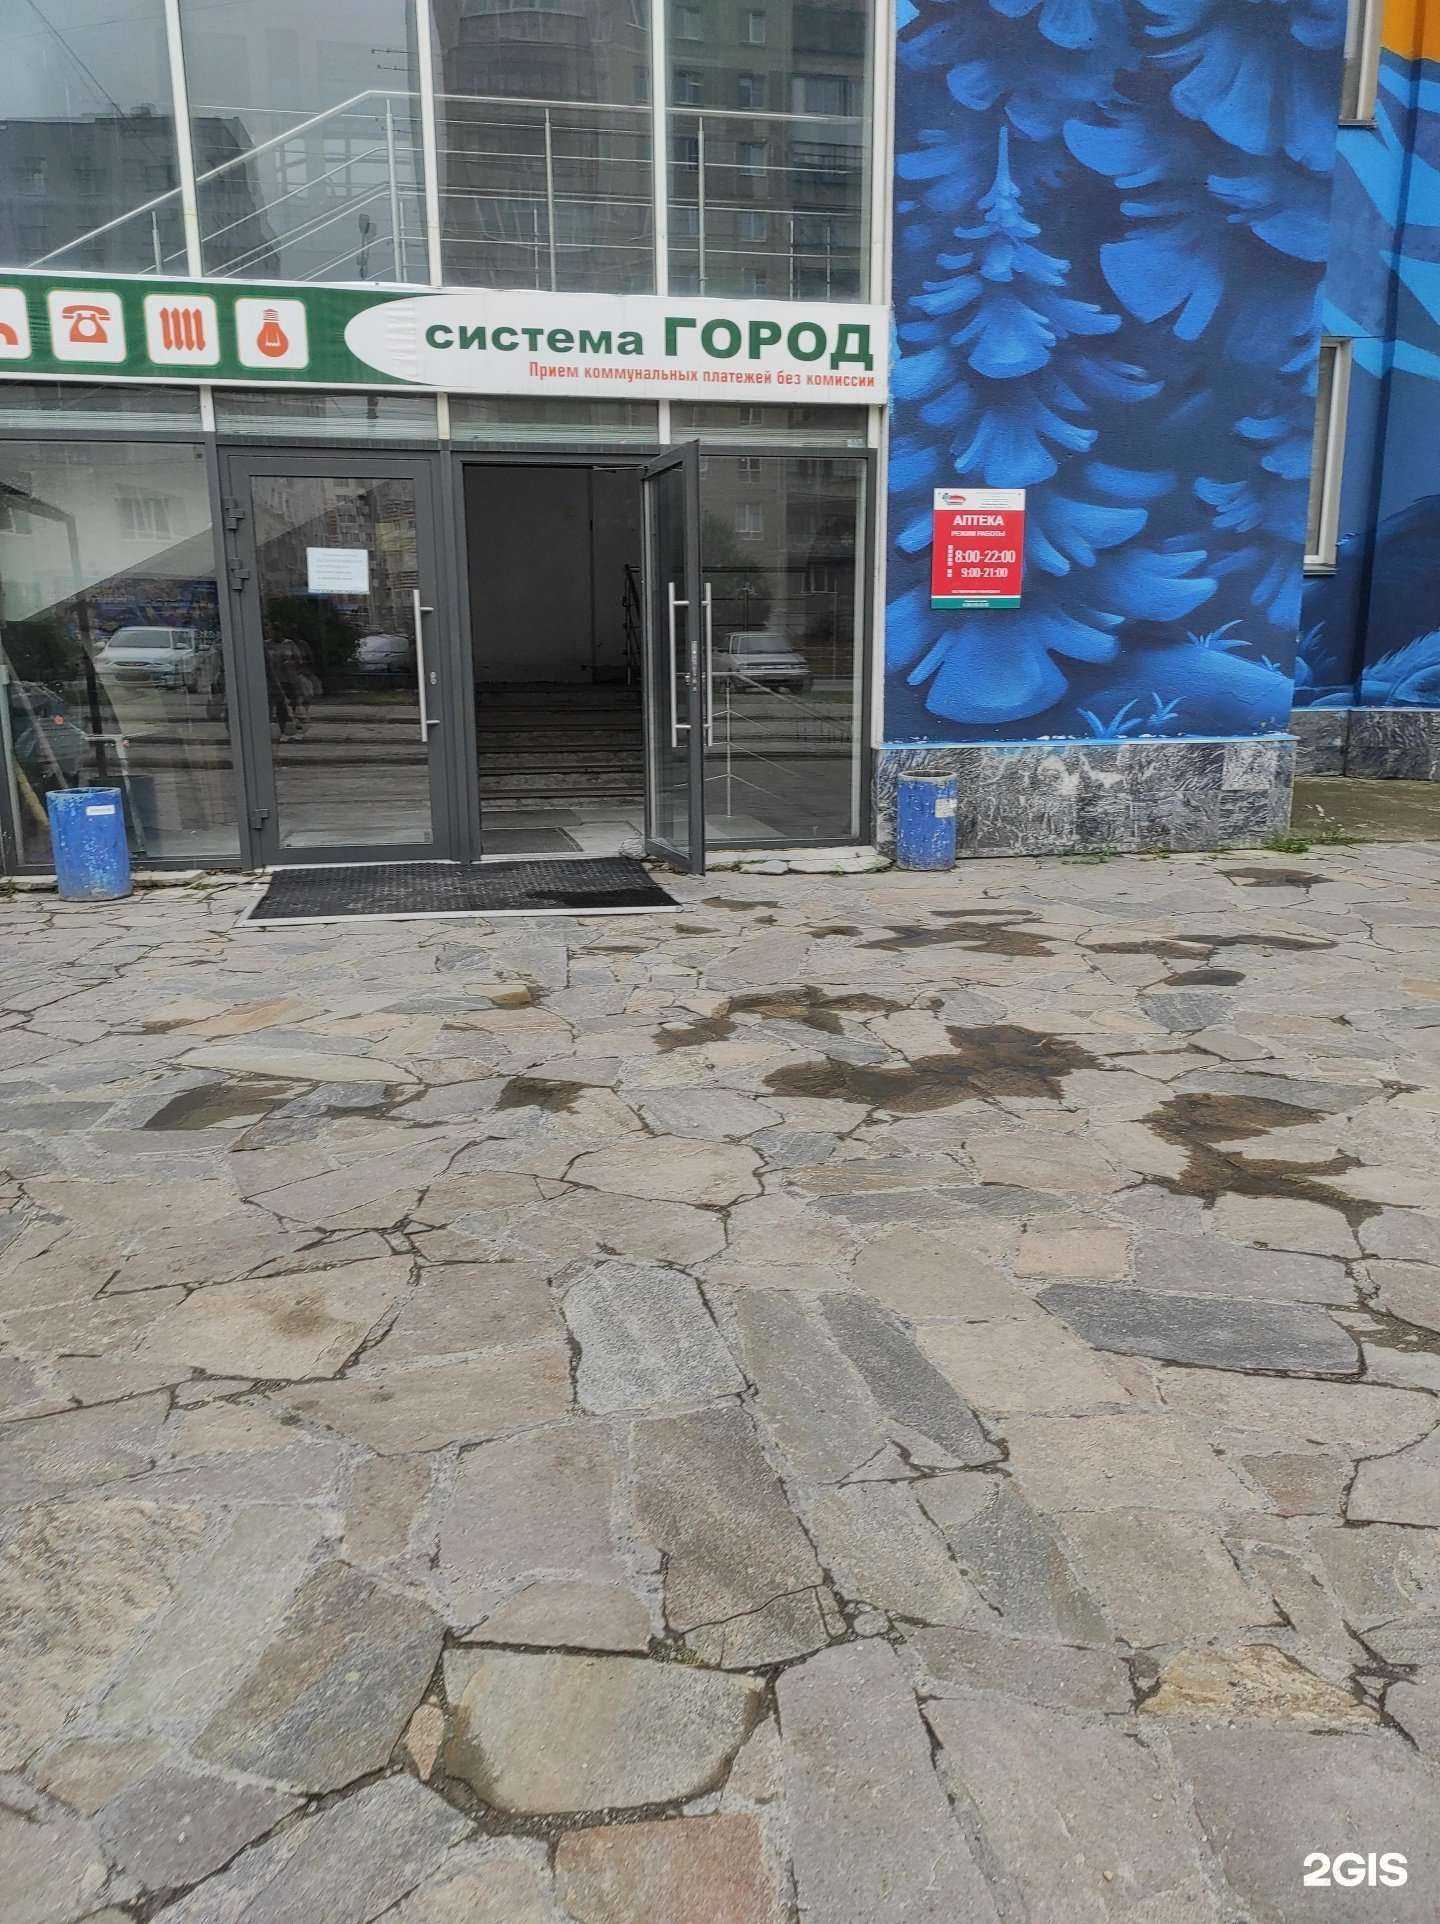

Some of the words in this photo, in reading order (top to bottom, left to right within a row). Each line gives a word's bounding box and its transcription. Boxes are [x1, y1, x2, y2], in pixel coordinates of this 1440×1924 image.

[425, 323, 644, 356] система
[664, 316, 875, 372] ГОРОД
[529, 361, 579, 380] Прием
[584, 365, 698, 383] коммунальных
[703, 369, 772, 386] платежей
[776, 370, 801, 385] без
[806, 372, 875, 387] комиссии
[953, 514, 1005, 526] АПТЕКА
[954, 550, 1016, 563] 8:00-22:00
